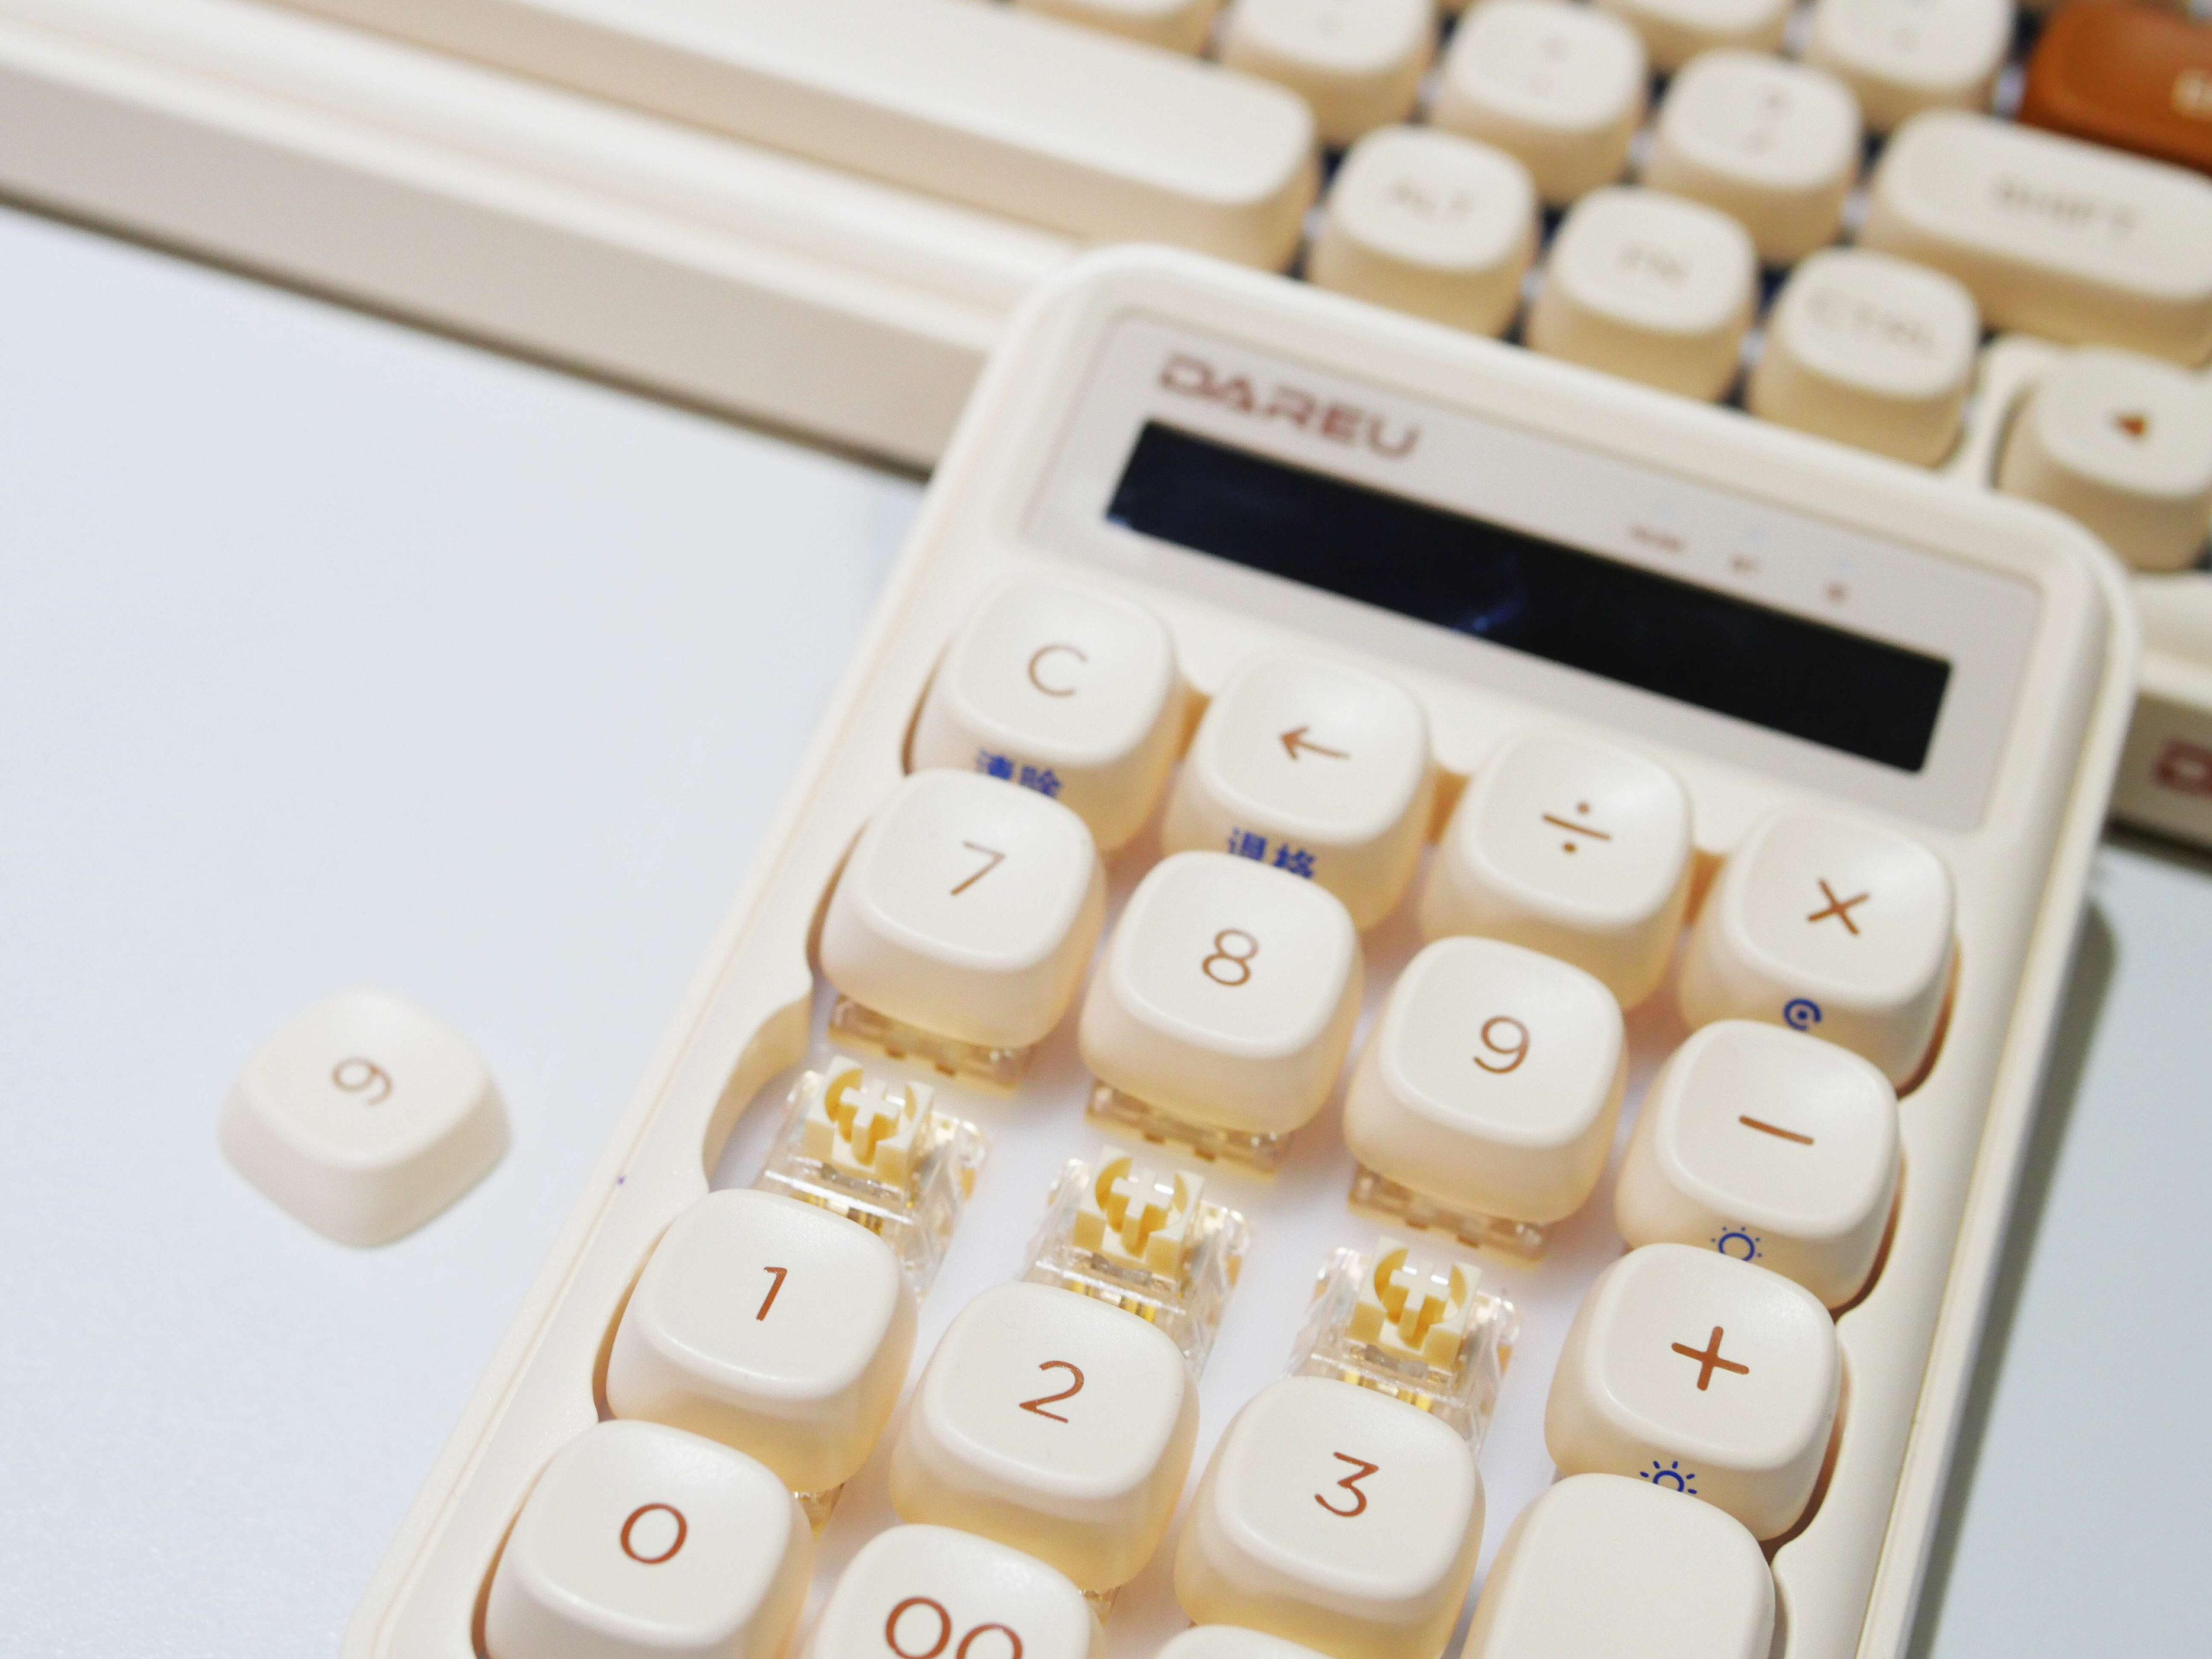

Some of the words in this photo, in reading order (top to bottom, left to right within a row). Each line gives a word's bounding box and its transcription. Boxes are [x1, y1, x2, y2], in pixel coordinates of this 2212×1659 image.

[1157, 354, 1419, 461] DAREU
[1028, 643, 1090, 698] C
[950, 840, 1007, 896] 7
[1201, 927, 1260, 988] 8
[1472, 1015, 1530, 1075] 9
[755, 1266, 789, 1322] 1
[1019, 1360, 1084, 1424] 2
[1314, 1451, 1380, 1518] 3
[619, 1502, 689, 1566] 0
